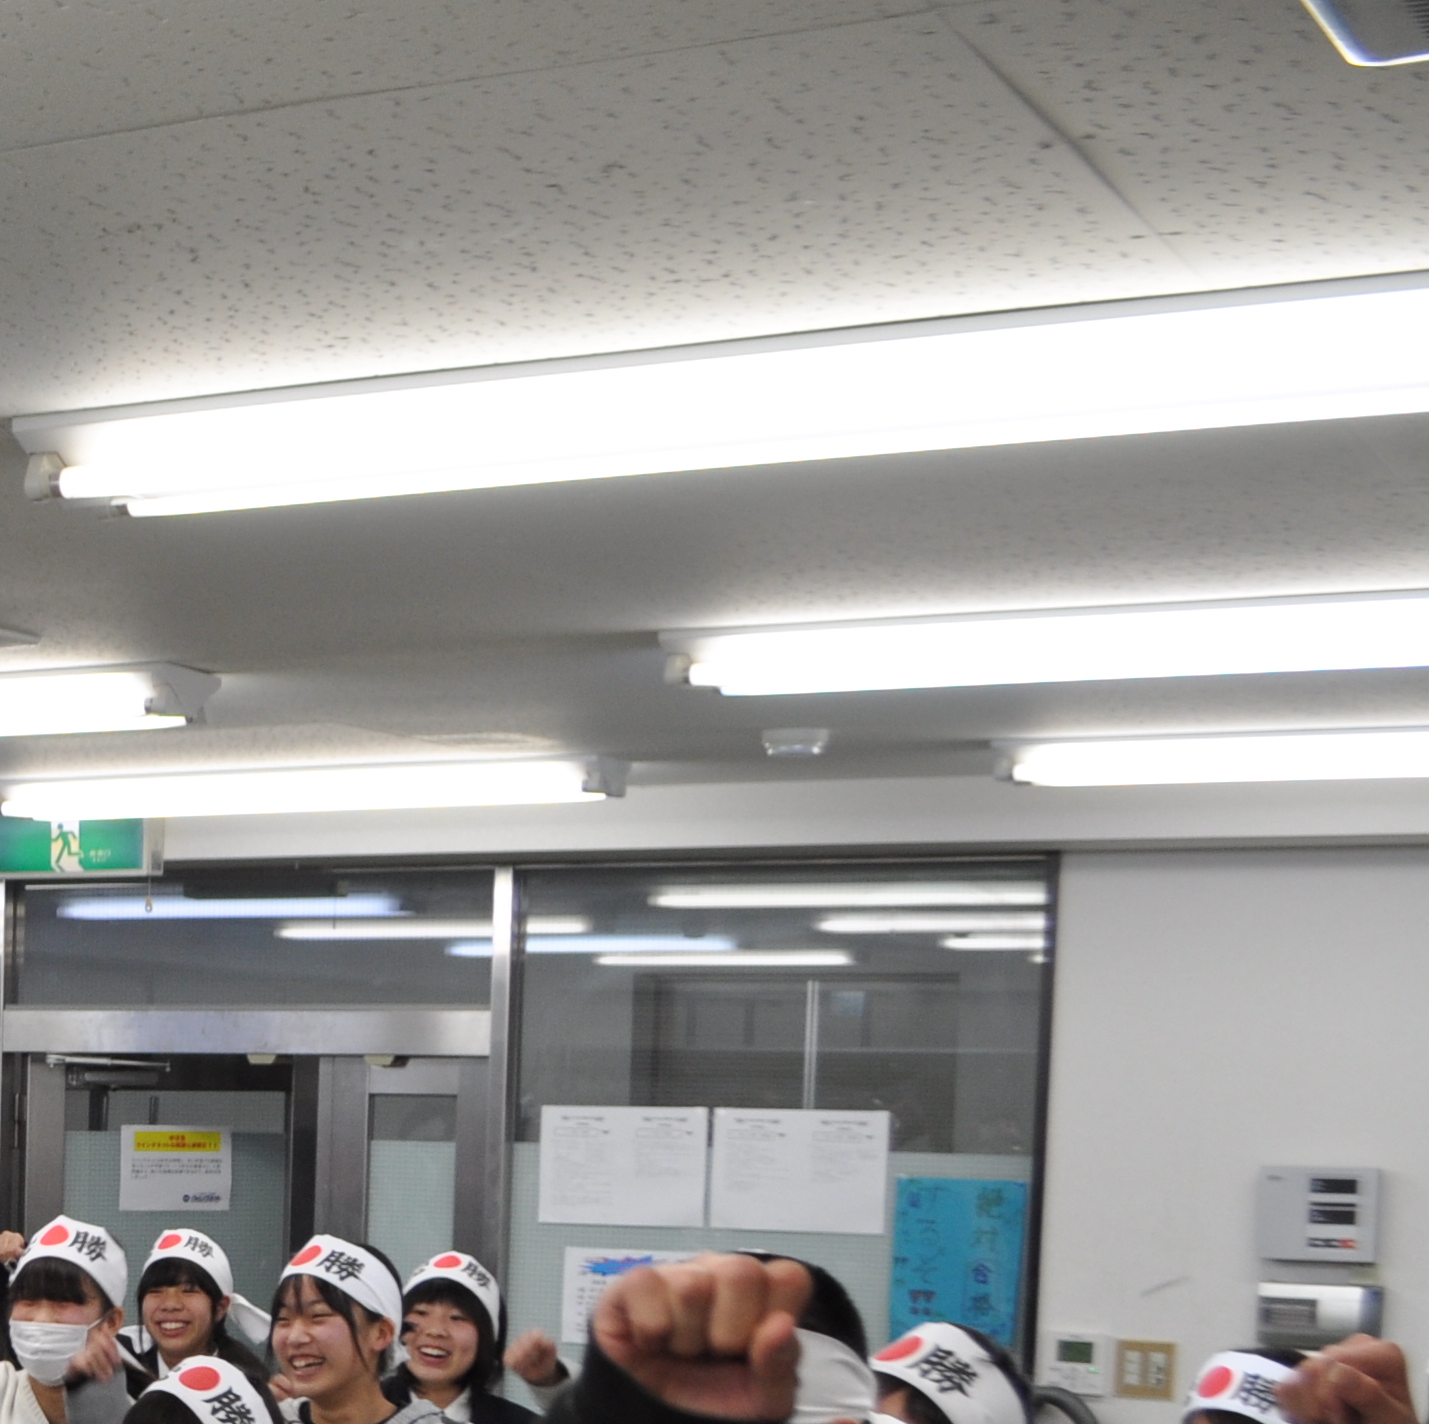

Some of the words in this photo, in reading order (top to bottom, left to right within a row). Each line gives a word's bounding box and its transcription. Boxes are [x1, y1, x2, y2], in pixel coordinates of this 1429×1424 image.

[68, 1231, 107, 1262] 勝
[183, 1236, 215, 1259] 勝
[315, 1249, 366, 1282] 勝
[460, 1260, 491, 1290] 勝
[904, 1345, 980, 1398] 勝
